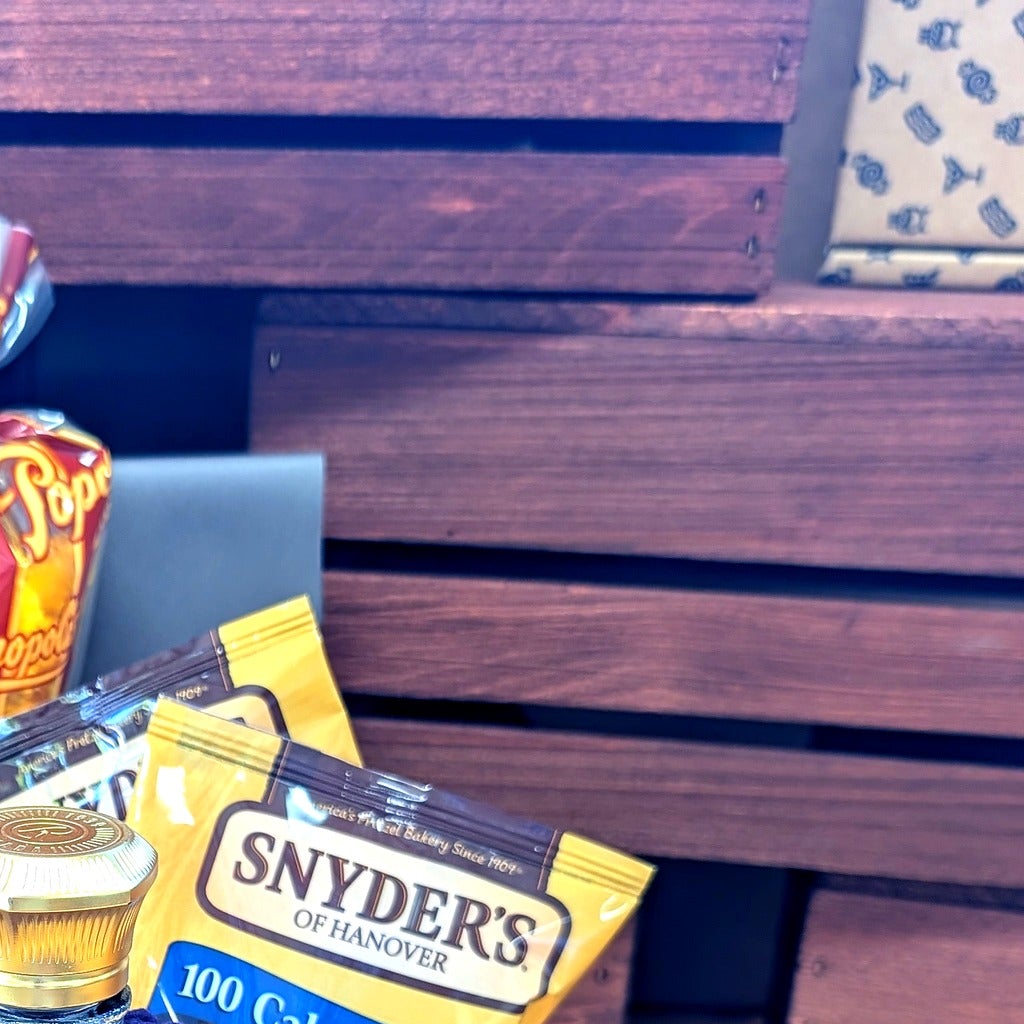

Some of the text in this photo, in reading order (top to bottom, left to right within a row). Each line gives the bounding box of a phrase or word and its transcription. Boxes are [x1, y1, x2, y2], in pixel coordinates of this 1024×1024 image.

[403, 824, 448, 854] Bakery
[451, 843, 486, 867] Since
[232, 831, 538, 968] SNYDER'S
[293, 908, 448, 974] OF HANOVER
[176, 963, 244, 1013] 100
